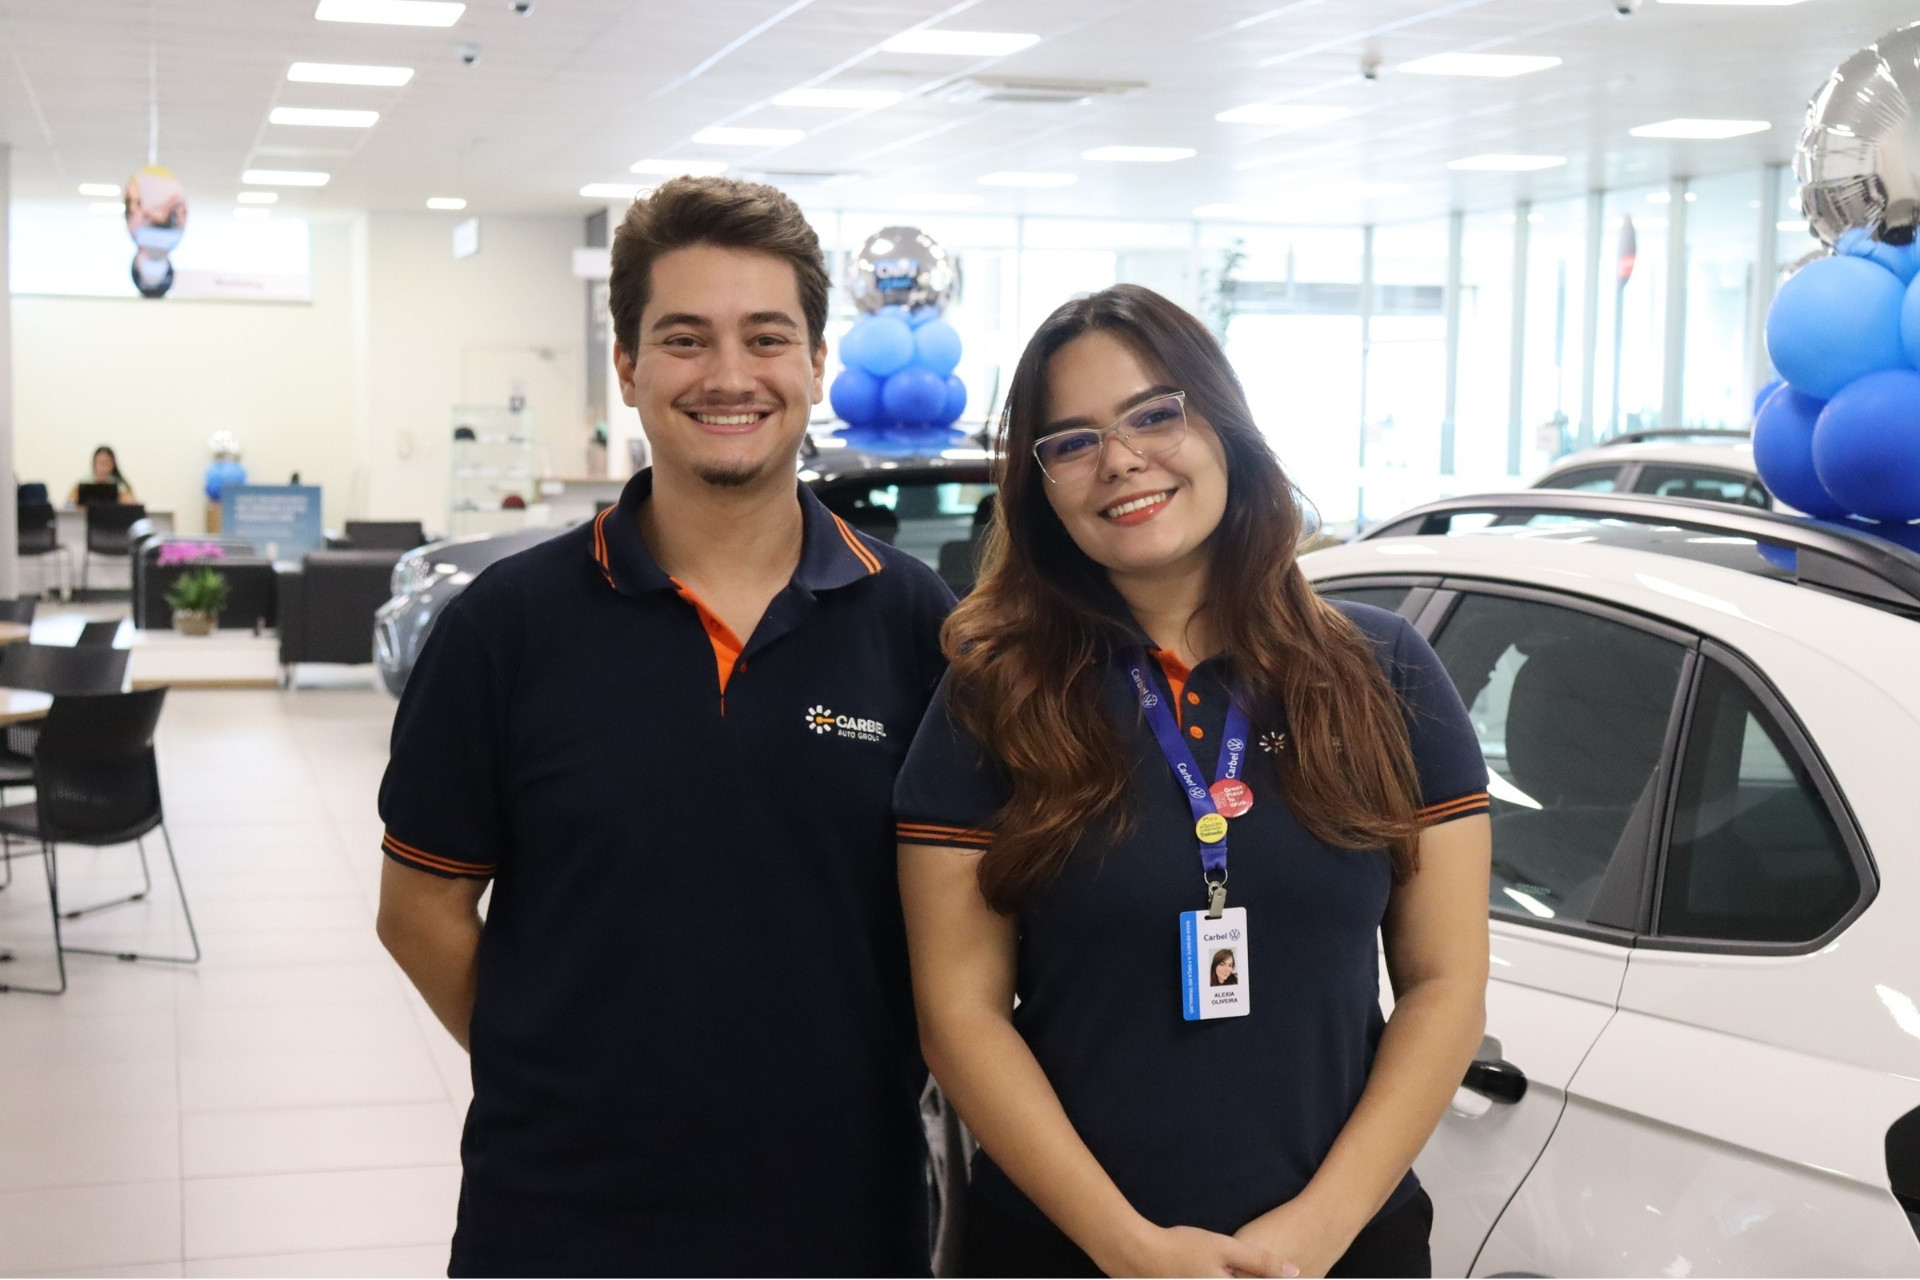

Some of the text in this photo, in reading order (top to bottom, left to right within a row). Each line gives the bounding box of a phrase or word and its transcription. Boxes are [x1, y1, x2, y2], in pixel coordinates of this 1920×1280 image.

[836, 715, 886, 737] CARBEL
[838, 730, 855, 738] AUTO
[1177, 762, 1197, 787] Carbel
[1225, 752, 1239, 779] Carbel
[1203, 932, 1228, 942] Carbel
